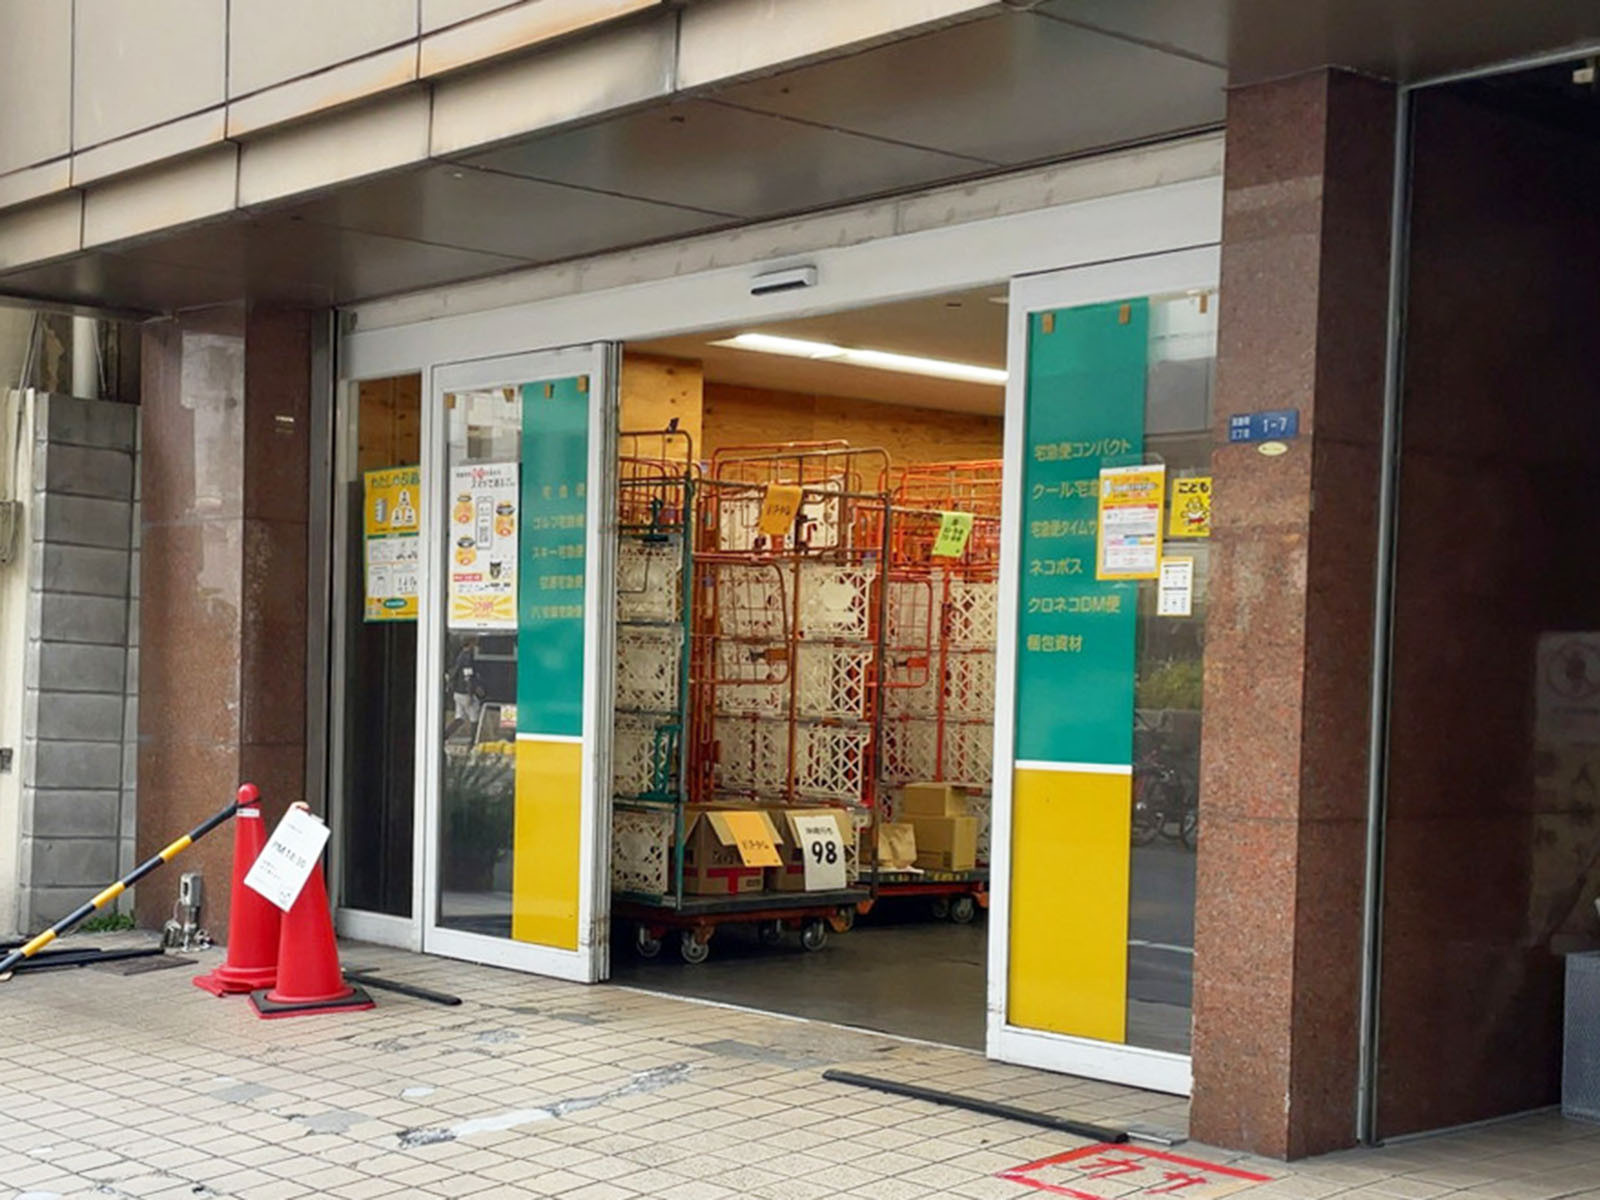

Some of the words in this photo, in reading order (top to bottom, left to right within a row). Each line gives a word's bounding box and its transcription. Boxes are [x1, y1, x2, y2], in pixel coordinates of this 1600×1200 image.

[1263, 416, 1288, 433] 1-7
[1034, 439, 1131, 462] 宅急便コンパクト
[1178, 481, 1209, 494] こども
[1029, 556, 1083, 576] ネコポス
[1027, 594, 1121, 614] クロネコDM便
[811, 840, 838, 865] 98
